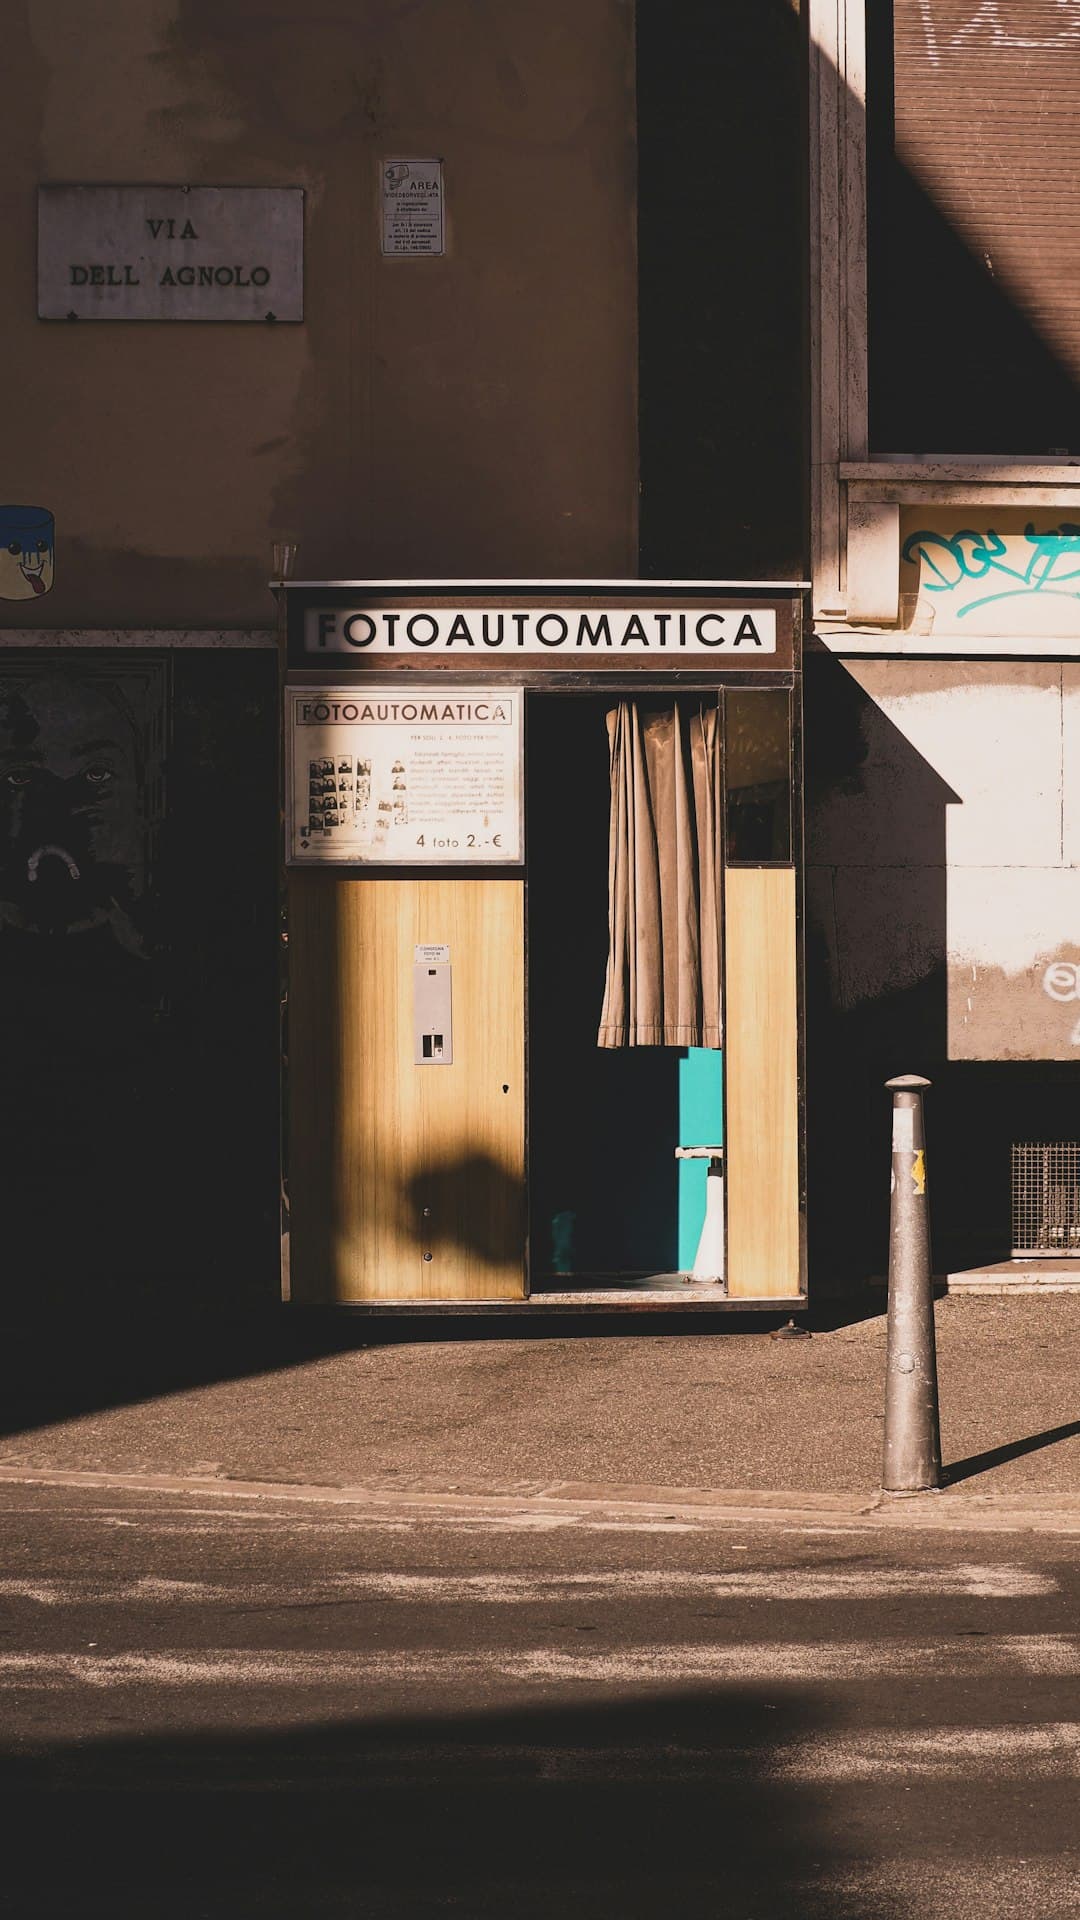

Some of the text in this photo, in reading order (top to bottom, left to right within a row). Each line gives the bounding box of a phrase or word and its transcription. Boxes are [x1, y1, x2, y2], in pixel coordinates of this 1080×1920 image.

[410, 182, 439, 190] AREA
[146, 219, 199, 240] VIA
[70, 265, 271, 287] DELL AGNOLO
[317, 613, 762, 647] FOTOAUTOMATICA
[303, 704, 506, 721] FOTOAUTOMATICA
[416, 834, 425, 848] 4
[433, 837, 459, 848] foto
